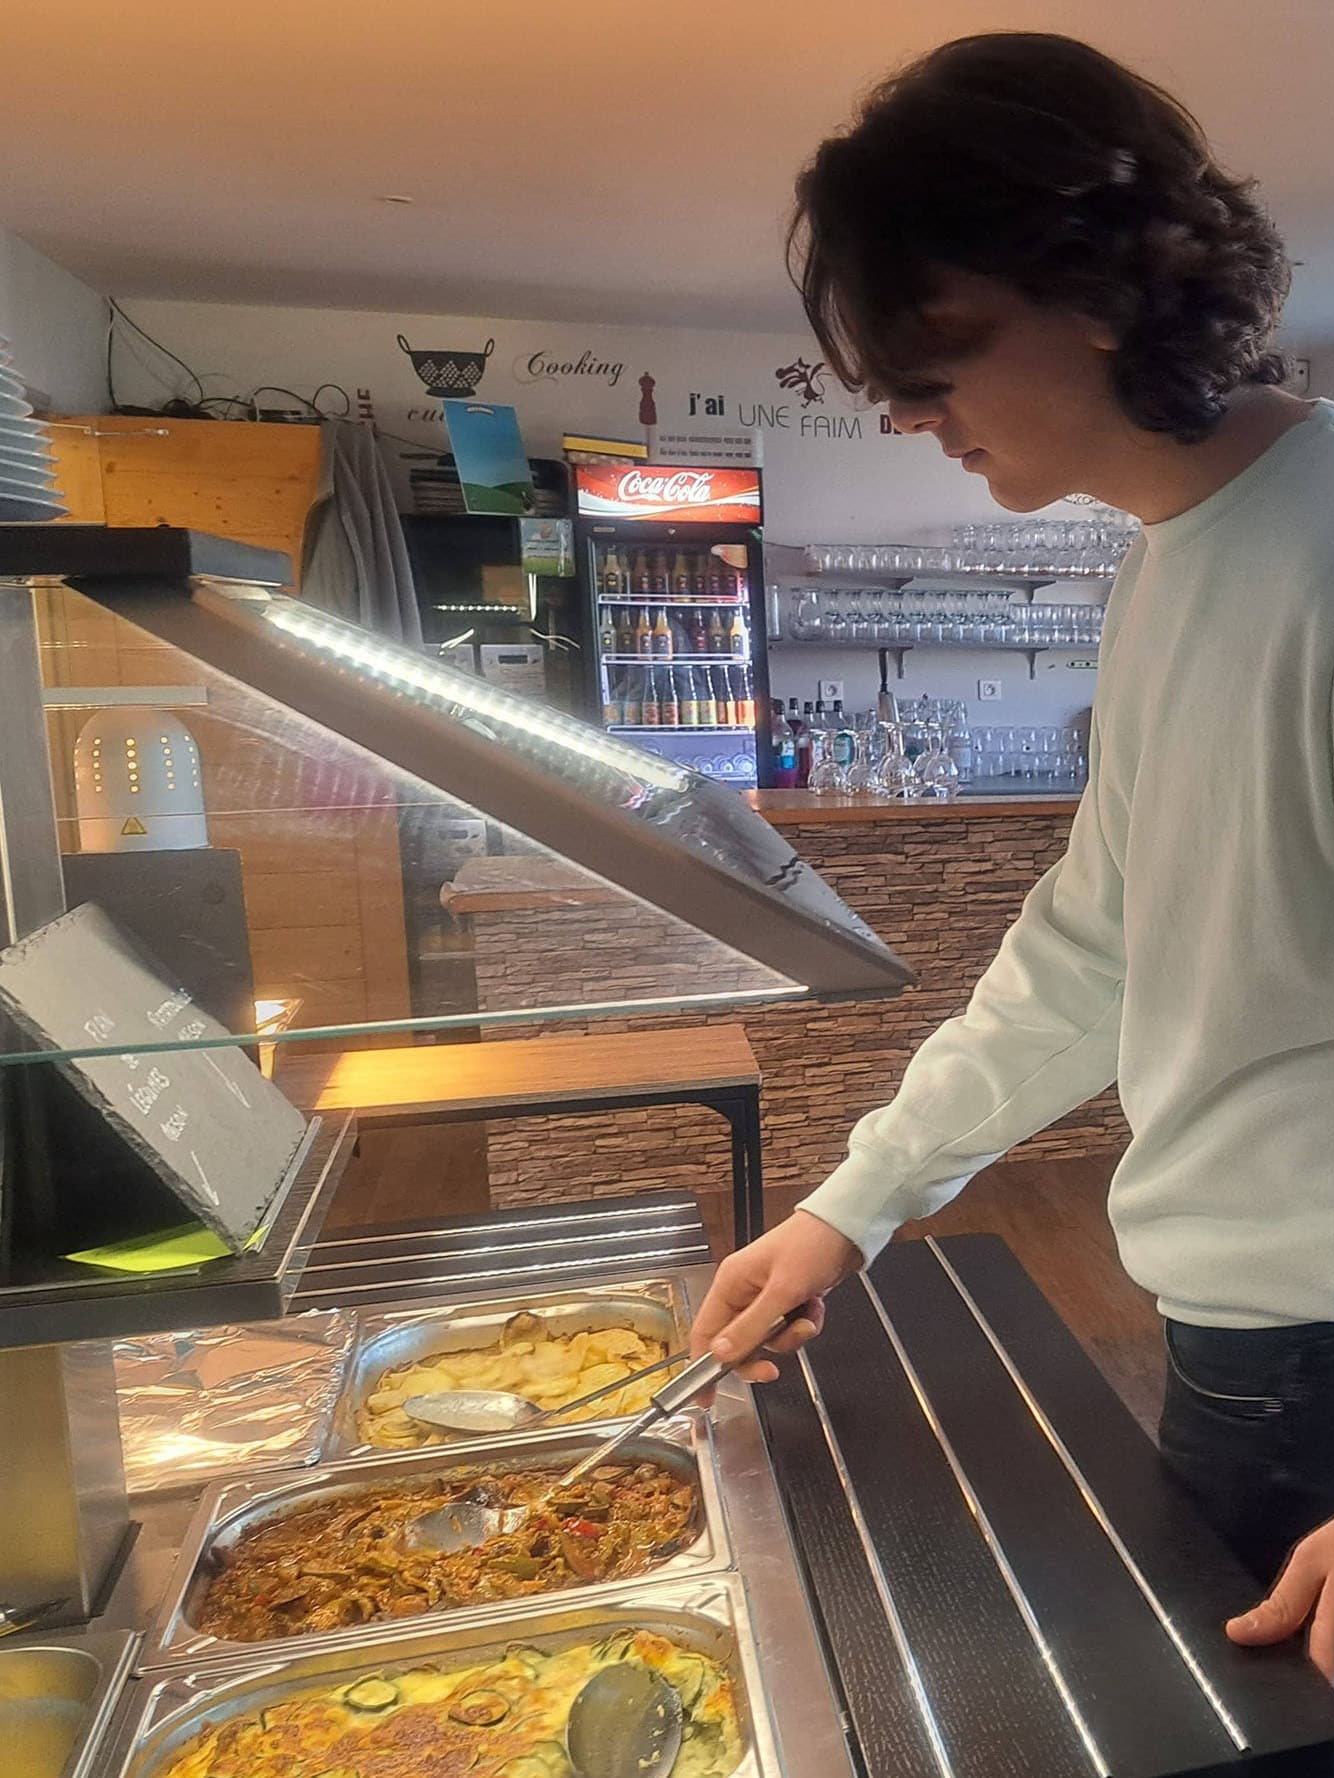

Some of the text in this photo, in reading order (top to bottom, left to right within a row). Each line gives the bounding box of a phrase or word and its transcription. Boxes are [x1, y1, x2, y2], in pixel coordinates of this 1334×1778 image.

[513, 350, 624, 387] Cooking
[689, 393, 725, 416] j'ai
[739, 404, 791, 428] UNE
[800, 415, 863, 440] FAIM
[618, 470, 715, 502] Coca-Cola
